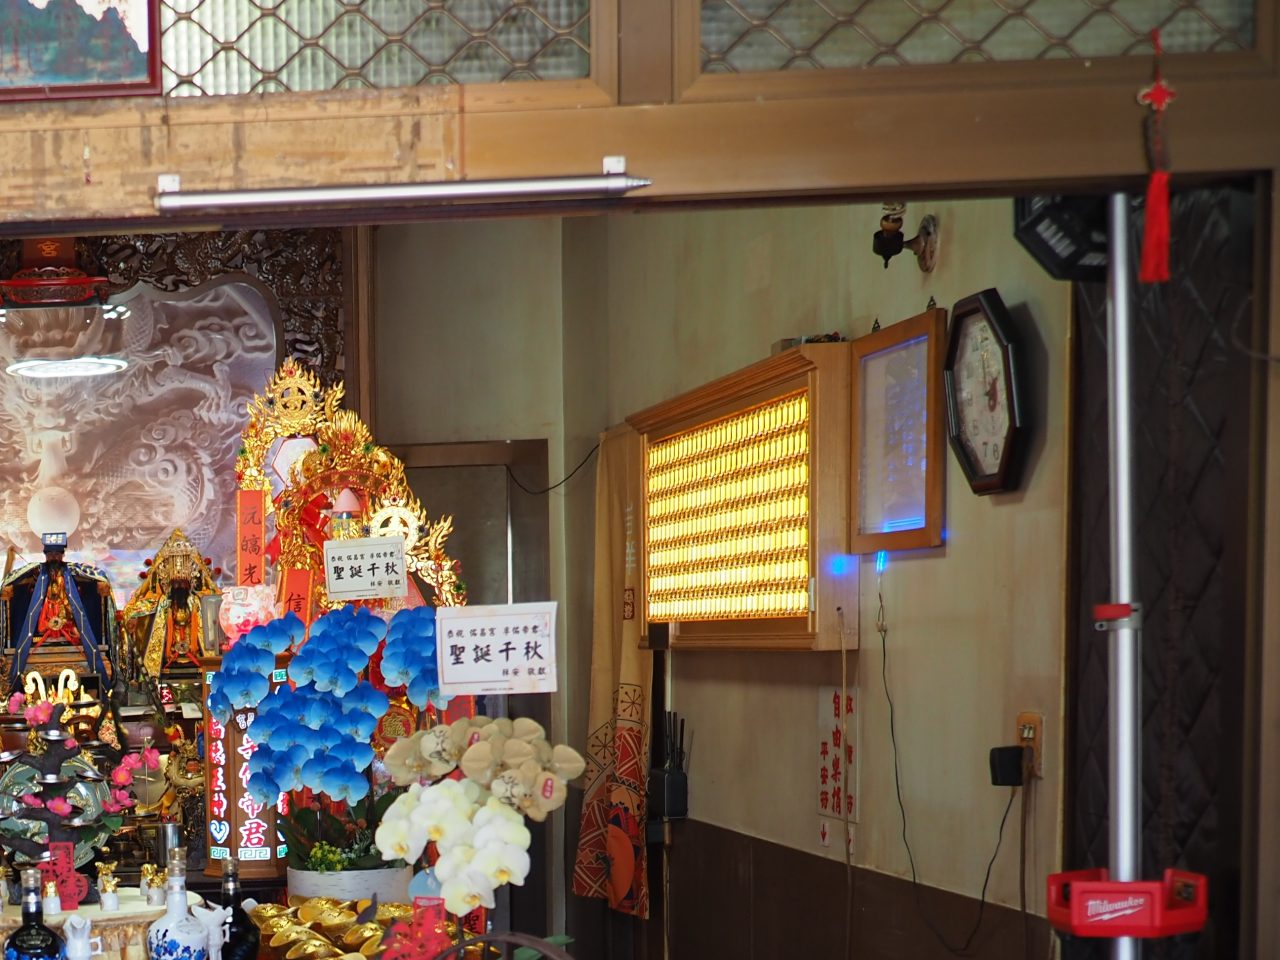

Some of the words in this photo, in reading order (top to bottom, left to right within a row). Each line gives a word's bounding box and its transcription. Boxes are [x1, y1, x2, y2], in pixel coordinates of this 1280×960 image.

[333, 562, 399, 580] 聖誕千秋
[450, 641, 544, 665] 聖誕千秋
[1086, 897, 1145, 916] Milwaukee
